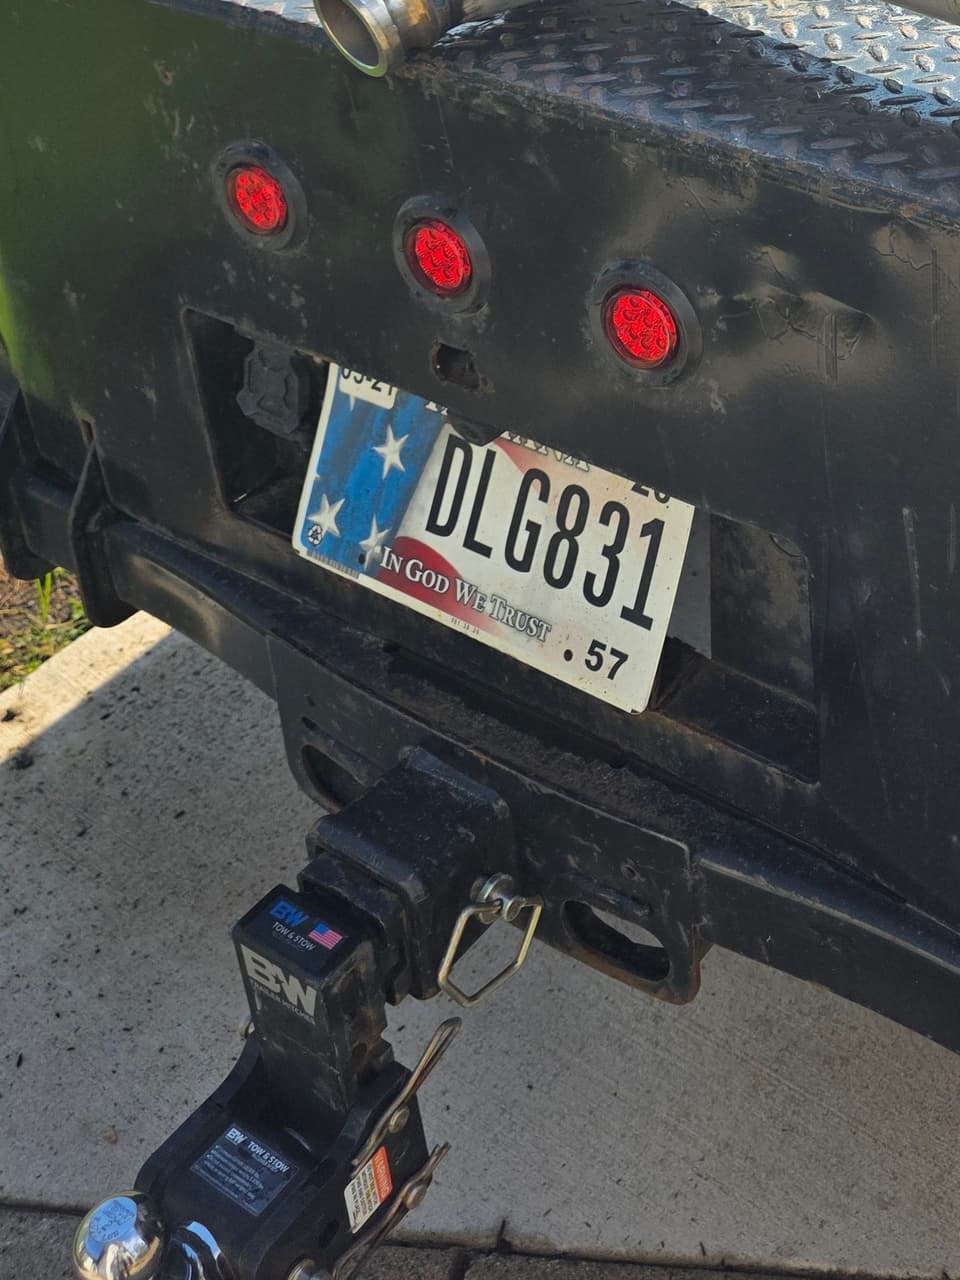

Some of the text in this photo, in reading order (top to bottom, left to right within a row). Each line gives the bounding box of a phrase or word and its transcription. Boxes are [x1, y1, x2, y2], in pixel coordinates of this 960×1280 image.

[425, 432, 667, 632] DLG831
[379, 546, 404, 575] IN
[405, 558, 450, 595] GOD
[453, 577, 486, 613] WE
[490, 593, 552, 643] TRUST
[584, 639, 629, 681] 57
[271, 921, 290, 937] TOW
[293, 935, 317, 952] STOW
[247, 1141, 266, 1156] TOW
[268, 1156, 290, 1173] STOW
